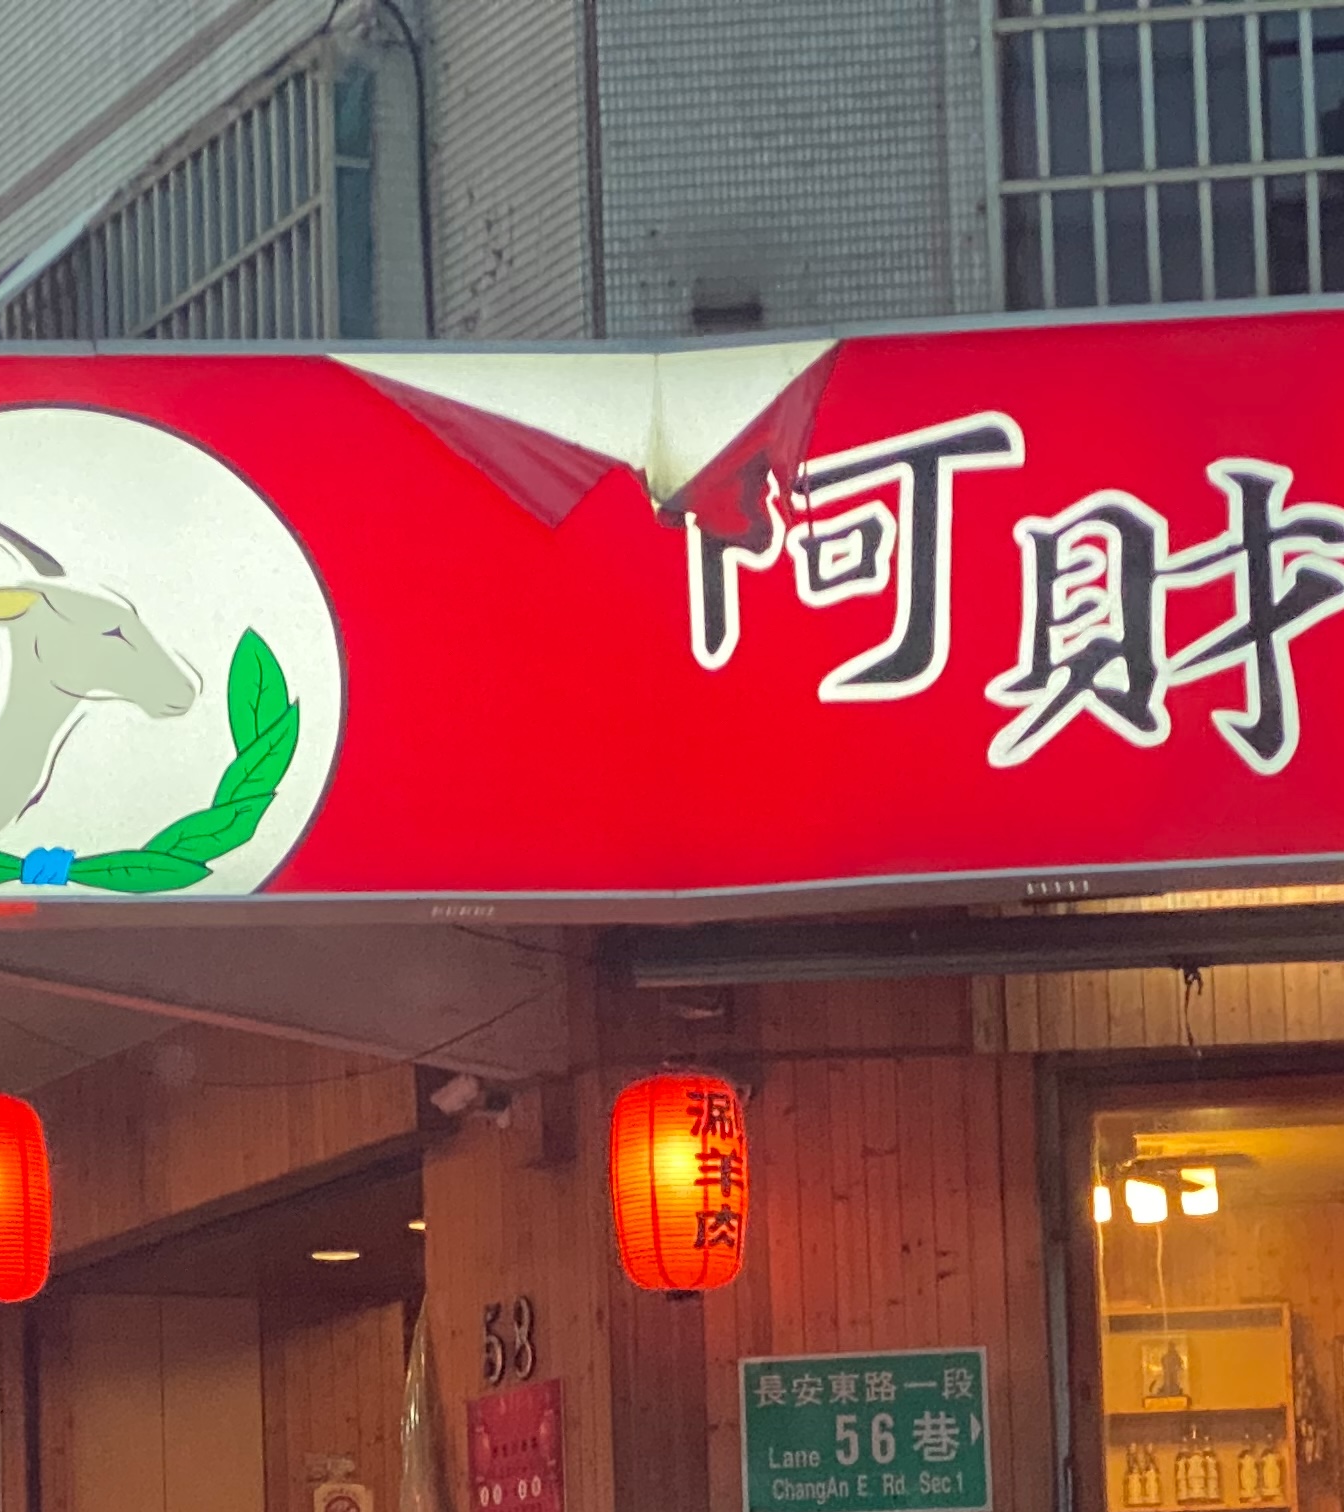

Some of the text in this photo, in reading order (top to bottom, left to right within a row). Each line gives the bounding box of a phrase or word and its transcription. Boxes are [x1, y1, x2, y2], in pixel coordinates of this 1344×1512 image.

[483, 1295, 536, 1387] 58
[753, 1367, 975, 1408] 長安東路一段
[768, 1410, 960, 1469] Lane 56 巷
[772, 1477, 849, 1505] ChangAn
